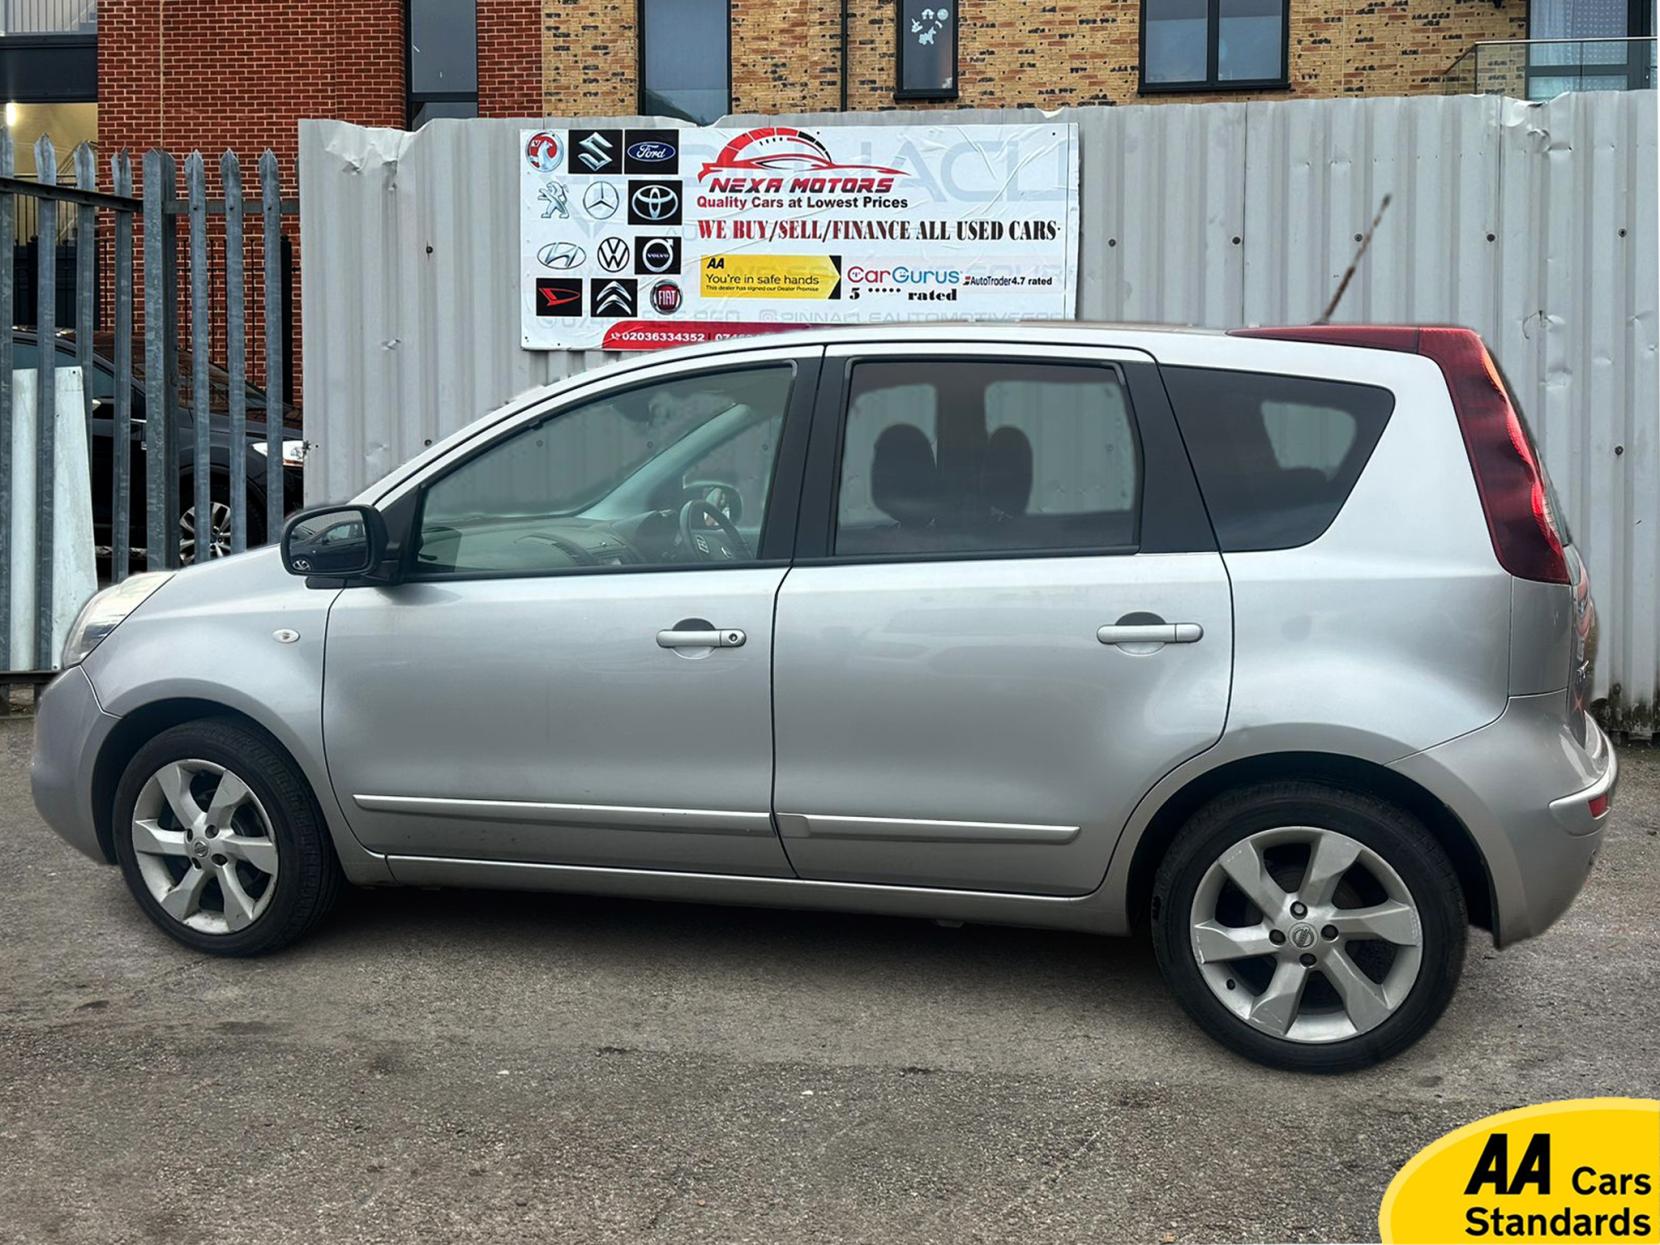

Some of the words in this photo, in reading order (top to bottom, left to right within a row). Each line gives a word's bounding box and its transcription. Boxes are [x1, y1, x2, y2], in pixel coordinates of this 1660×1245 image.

[636, 144, 666, 160] Ford
[708, 177, 784, 193] NEXA
[789, 177, 895, 194] MOTORS
[697, 195, 748, 210] Quality
[752, 196, 784, 208] Cars
[788, 196, 802, 208] at
[807, 196, 859, 208] Lowest
[863, 196, 908, 208] Prices
[697, 219, 727, 239] WE
[733, 219, 910, 242] BUY/SELL/FINANCE
[916, 220, 951, 240] ALL
[956, 220, 1004, 240] USED
[1008, 220, 1057, 240] CARS
[706, 257, 725, 269] AA
[706, 273, 741, 284] You're
[744, 274, 754, 284] in
[757, 274, 781, 285] safe
[784, 275, 820, 286] hands
[847, 265, 961, 284] CarGurus
[1028, 276, 1053, 285] rated
[658, 291, 677, 305] FIAT
[849, 287, 860, 300] 5
[908, 288, 957, 301] rated
[622, 332, 705, 342] 02036334352
